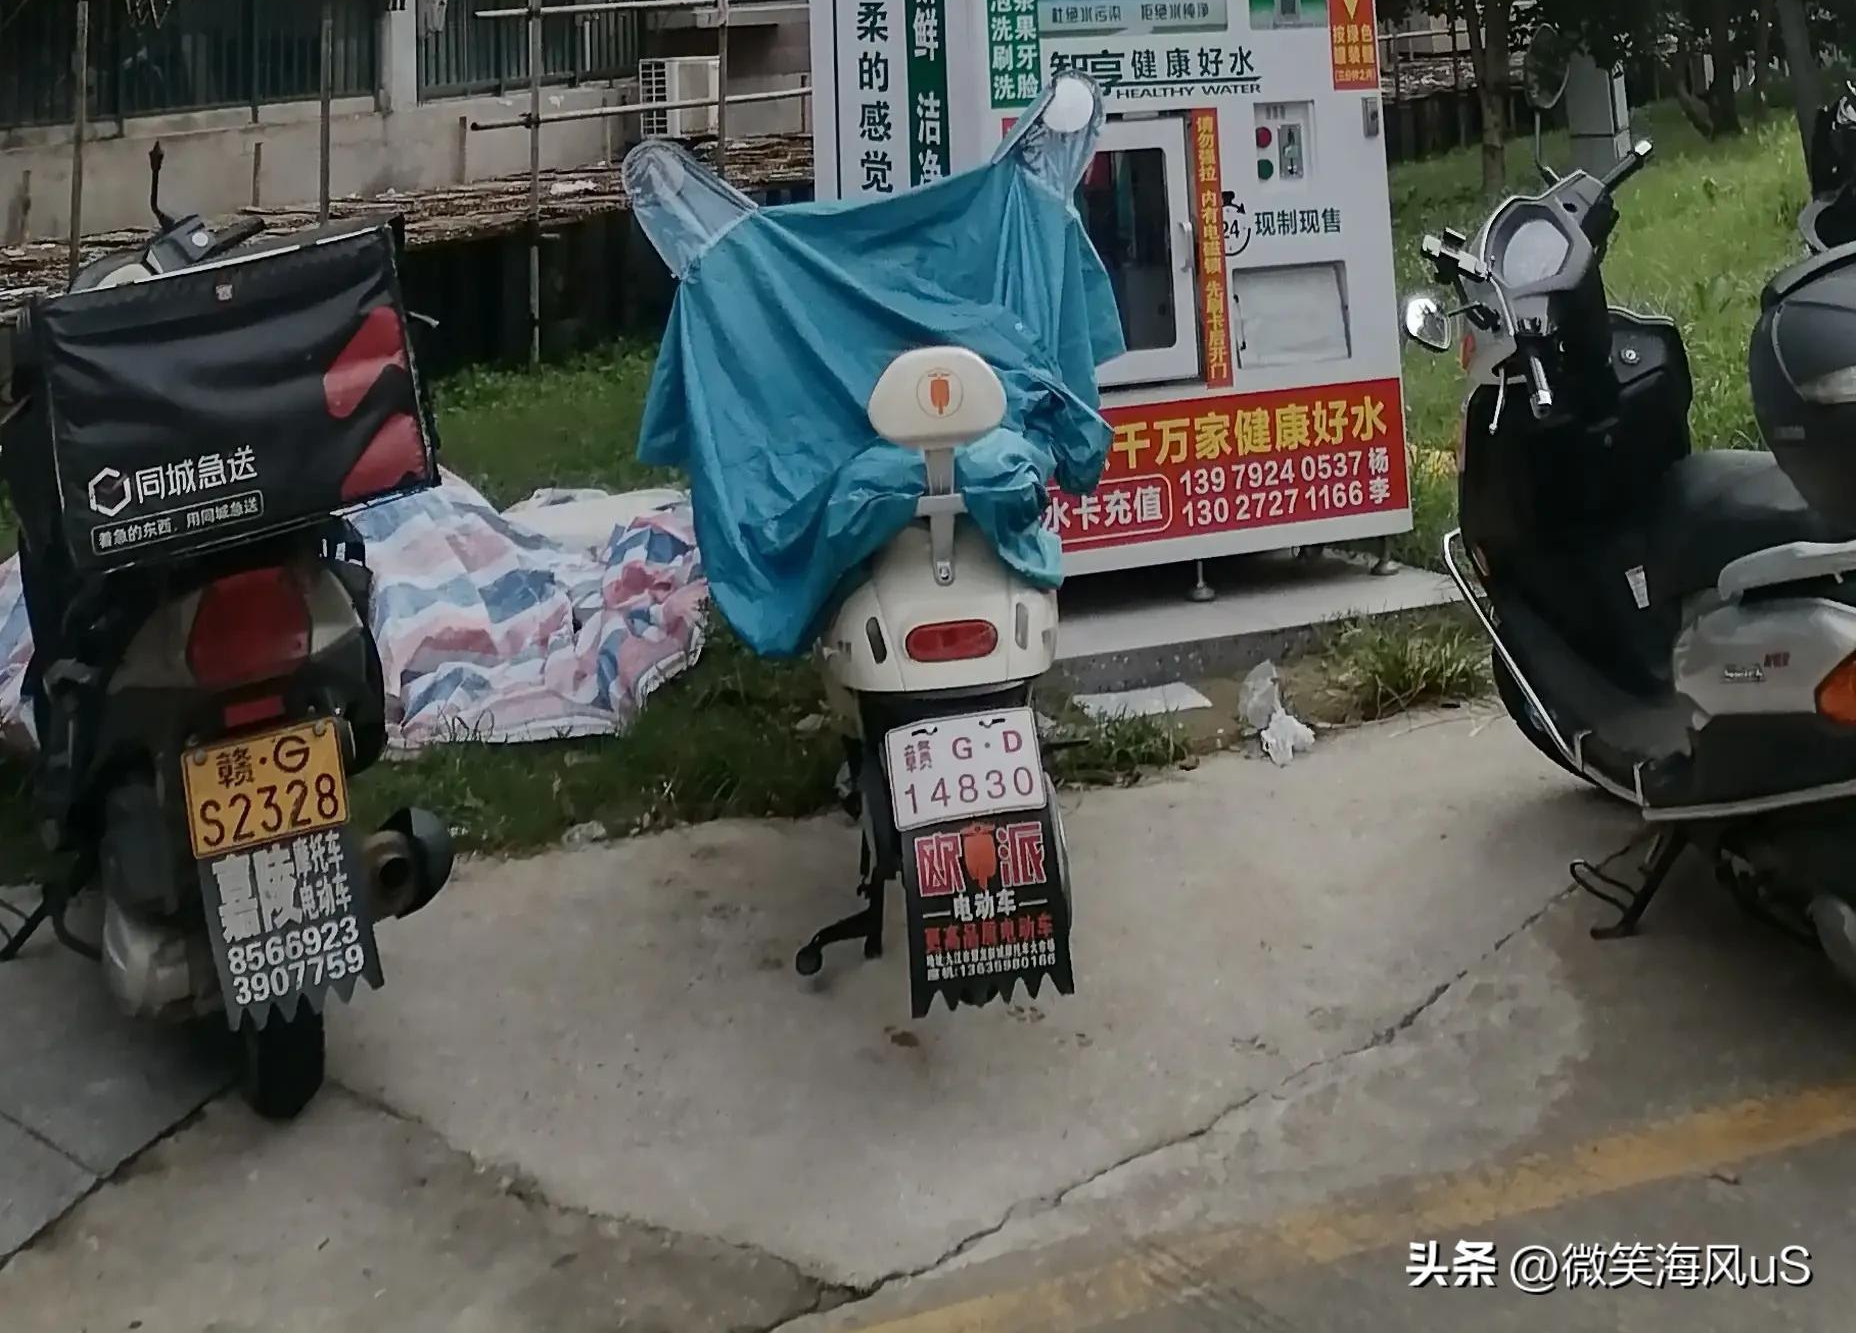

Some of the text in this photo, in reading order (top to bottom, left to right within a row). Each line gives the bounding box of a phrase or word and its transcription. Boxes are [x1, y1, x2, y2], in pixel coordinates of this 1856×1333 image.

[991, 15, 1037, 42] 洗果
[992, 44, 1038, 71] 刷牙
[994, 74, 1039, 100] 洗脸
[1117, 84, 1261, 99] HEALTHY WATER
[1255, 207, 1341, 236] 现制现售
[1104, 395, 1387, 471] 千万家健康好水
[135, 445, 258, 504] 同城急送
[1180, 447, 1390, 496] 139 7924 0537 杨
[1044, 485, 1163, 533] 水卡充值
[1182, 477, 1391, 527] 130 2727 1166 李
[200, 773, 339, 847] S2328
[904, 766, 1034, 815] 14830
[292, 830, 345, 878] 摩托车
[914, 821, 1047, 897] 欧派
[299, 873, 352, 920] 电动车
[953, 888, 1017, 922] 电动车
[227, 916, 359, 975] 8566923
[233, 944, 364, 1005] 3907759
